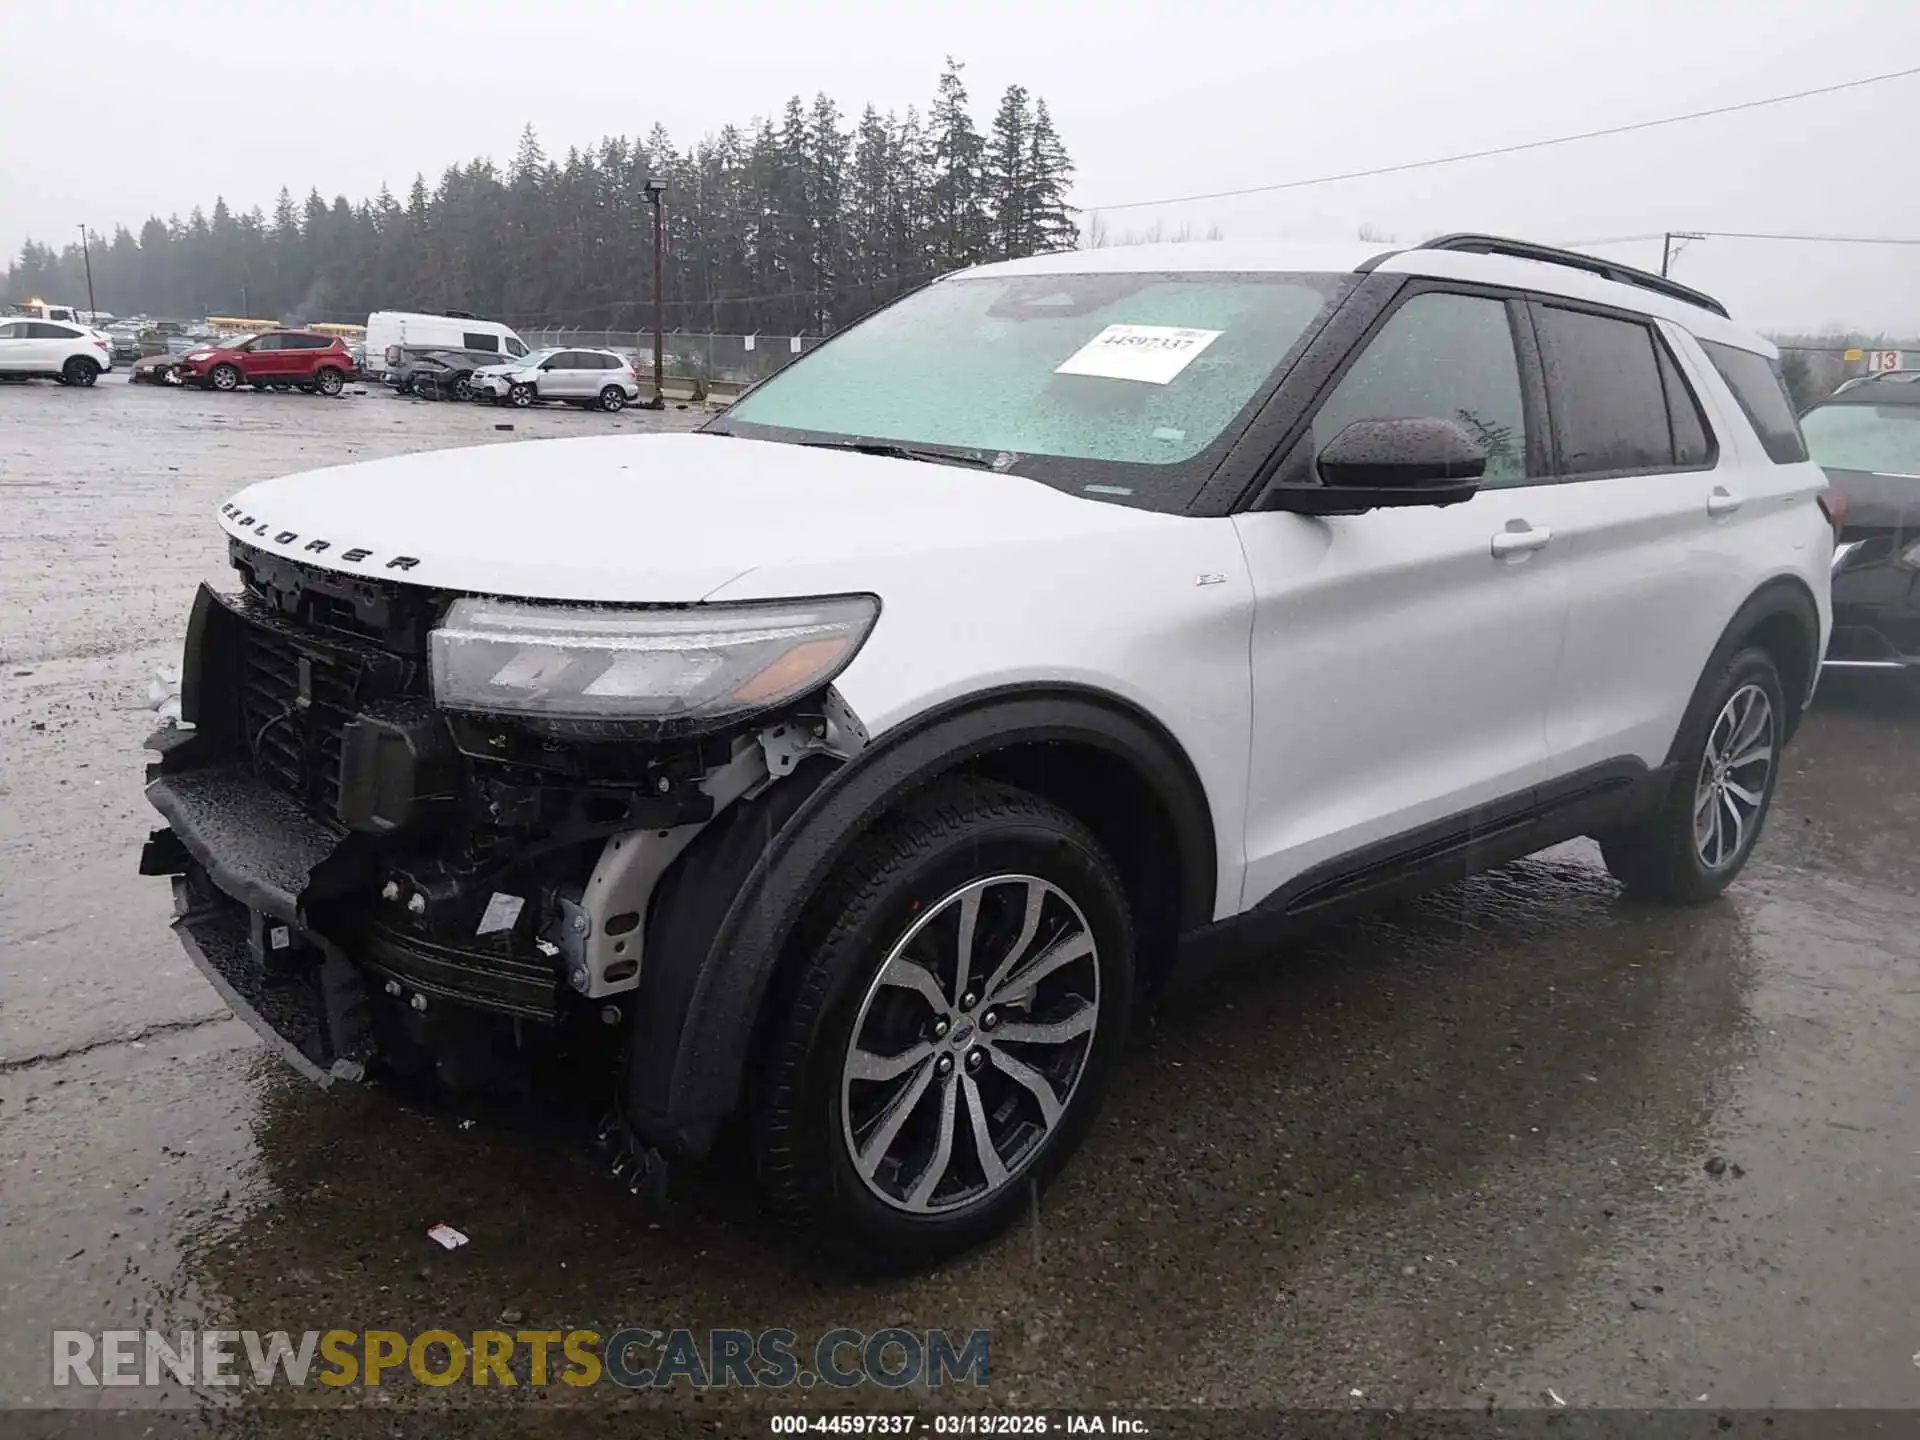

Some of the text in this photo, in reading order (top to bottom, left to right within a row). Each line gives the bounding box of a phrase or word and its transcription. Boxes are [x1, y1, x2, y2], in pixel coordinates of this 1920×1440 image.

[1102, 335, 1195, 350] 44597337
[1875, 351, 1897, 370] 13
[221, 502, 421, 572] EXPLORER
